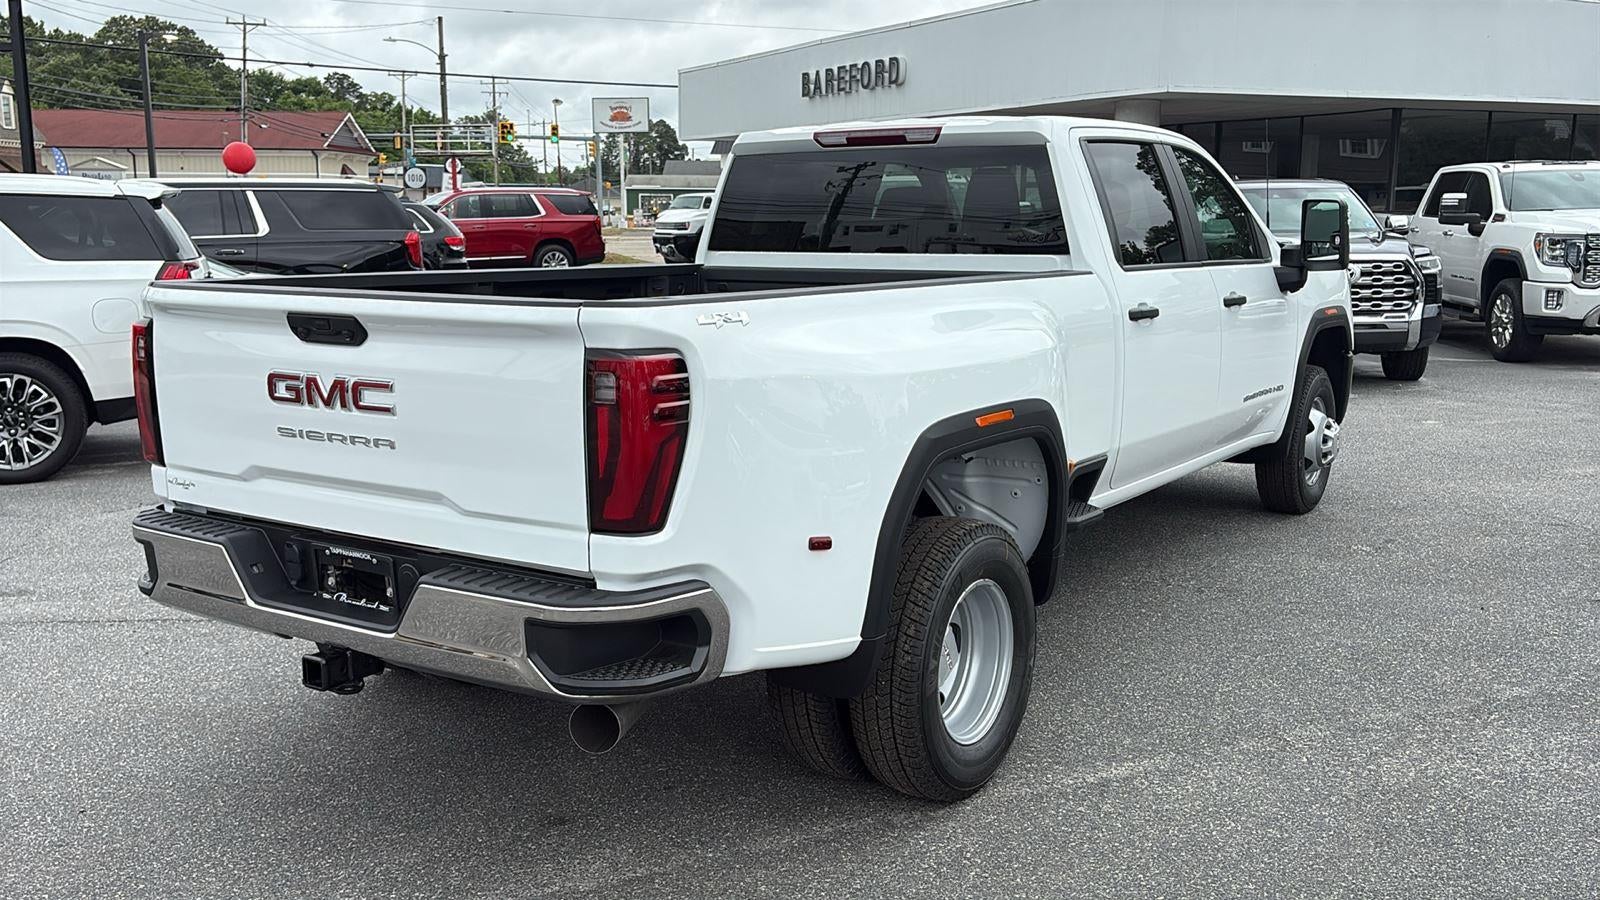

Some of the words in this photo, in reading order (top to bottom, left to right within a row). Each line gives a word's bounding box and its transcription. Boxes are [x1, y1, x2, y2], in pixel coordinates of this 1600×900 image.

[801, 56, 903, 98] BAREFORD
[407, 173, 424, 183] 1010
[266, 369, 397, 417] GMC
[276, 426, 397, 450] SIERRA
